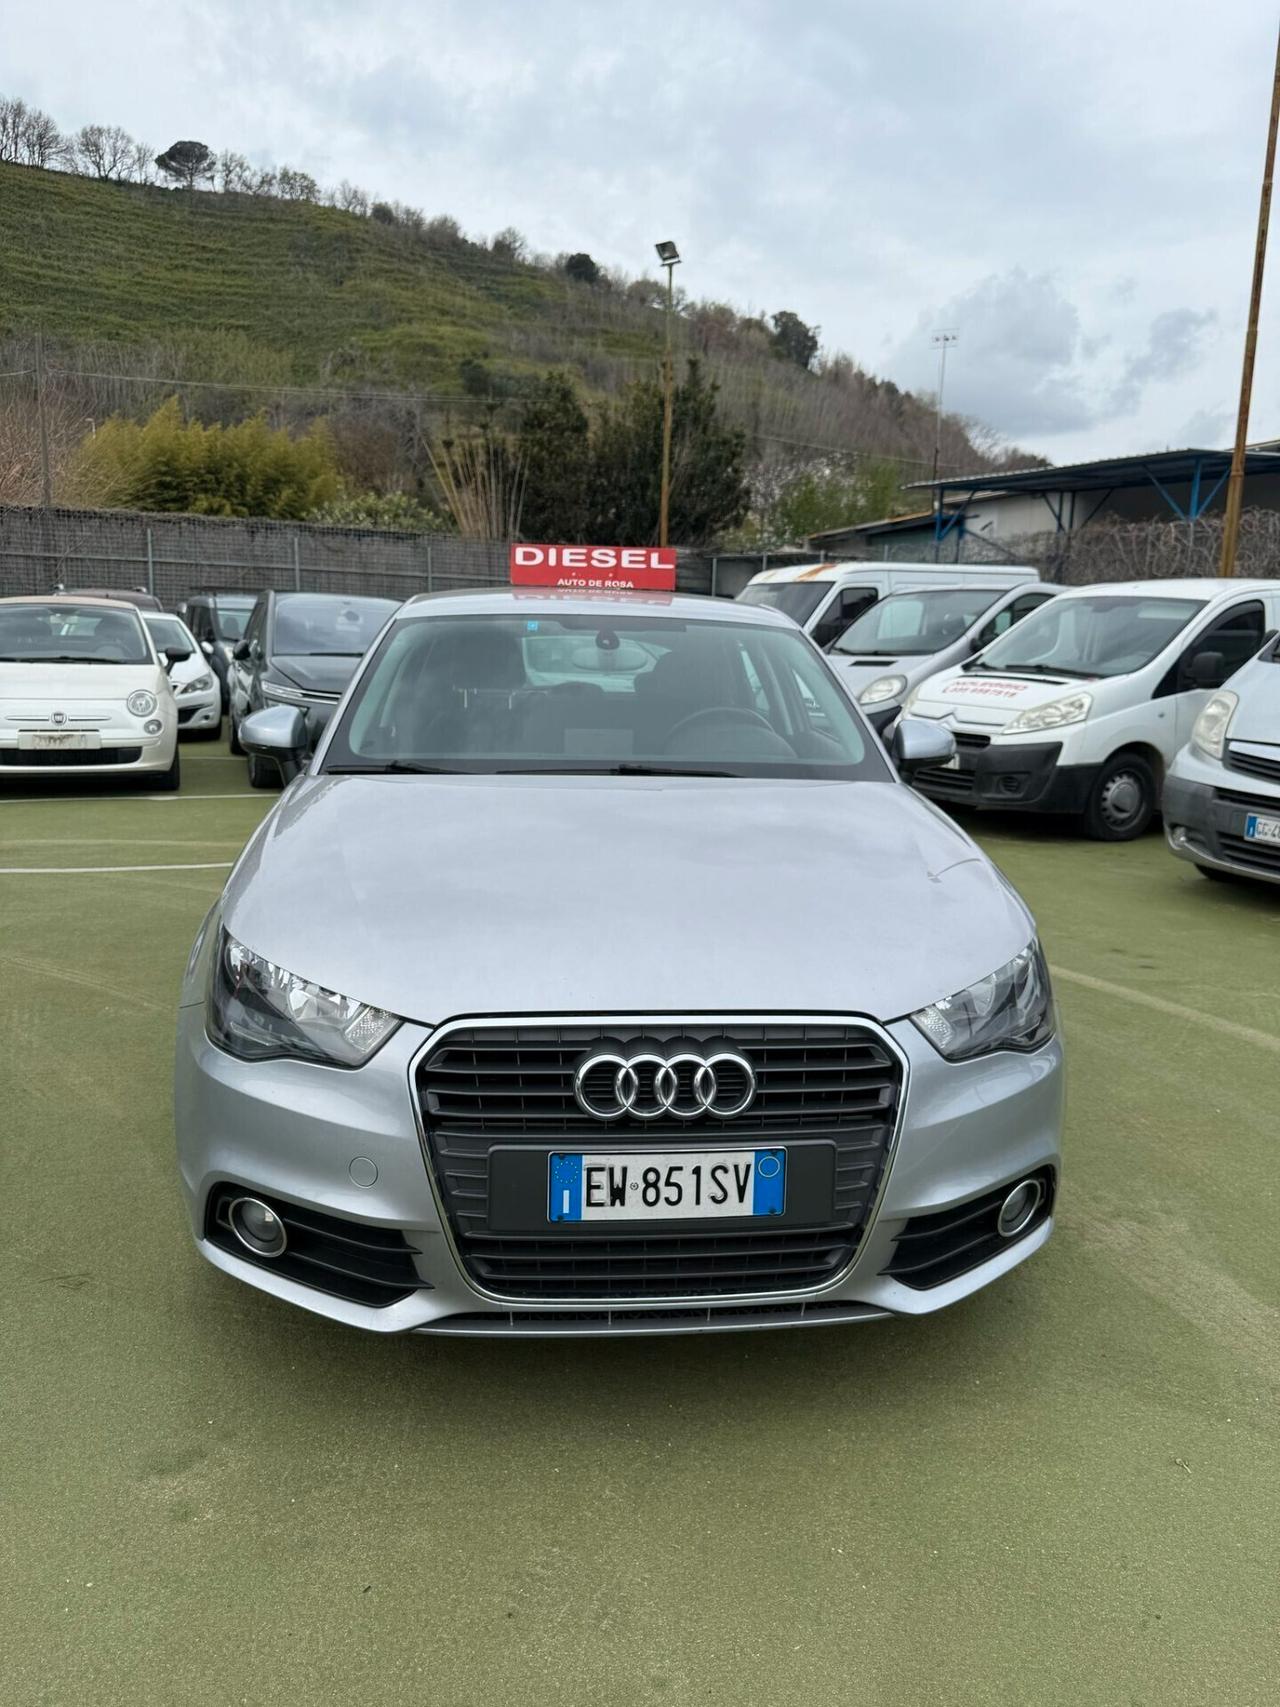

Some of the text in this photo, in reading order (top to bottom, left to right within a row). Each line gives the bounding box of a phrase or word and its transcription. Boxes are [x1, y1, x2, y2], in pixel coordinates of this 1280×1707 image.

[515, 547, 674, 569] DIESEL
[557, 578, 634, 589] AUTO DE ROSA
